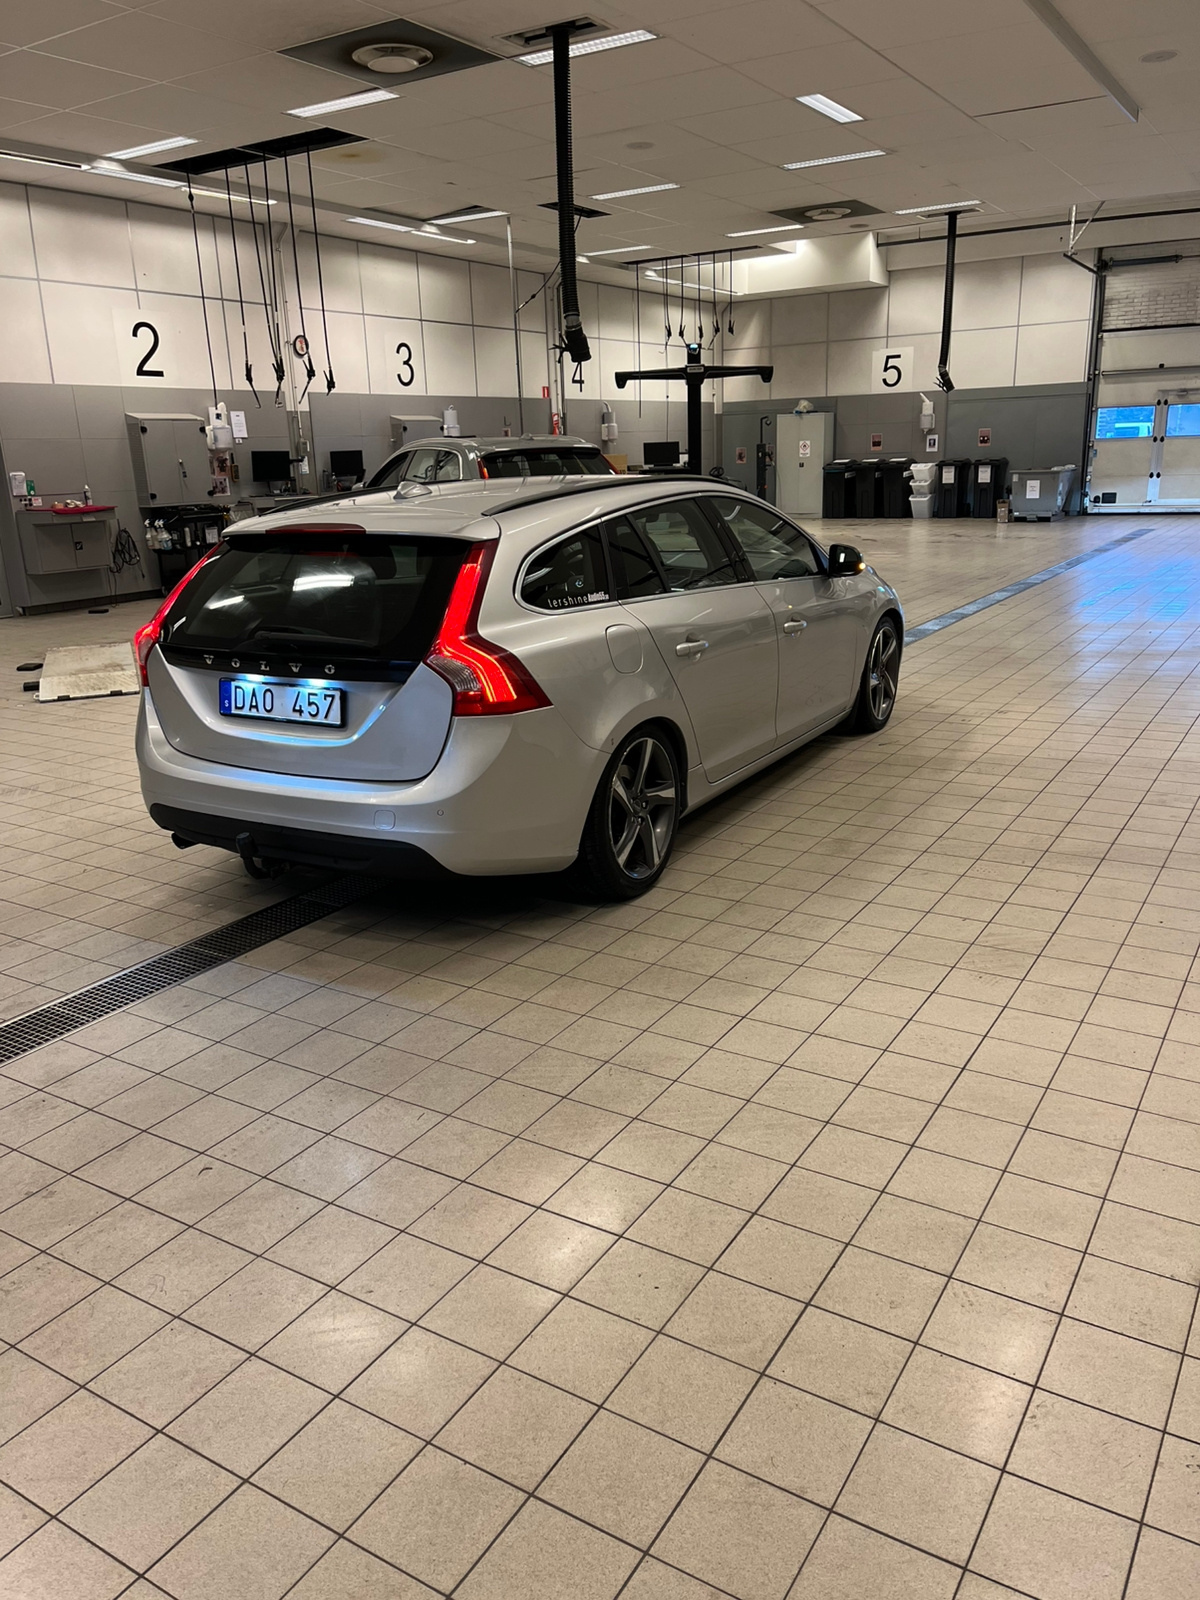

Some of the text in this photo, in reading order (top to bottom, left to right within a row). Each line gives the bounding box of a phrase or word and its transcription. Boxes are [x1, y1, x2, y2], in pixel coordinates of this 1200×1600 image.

[132, 321, 165, 378] 2
[395, 342, 415, 387] 3
[571, 361, 585, 393] 4
[881, 354, 902, 388] 5
[203, 654, 335, 674] VOLVO
[292, 691, 336, 720] 457
